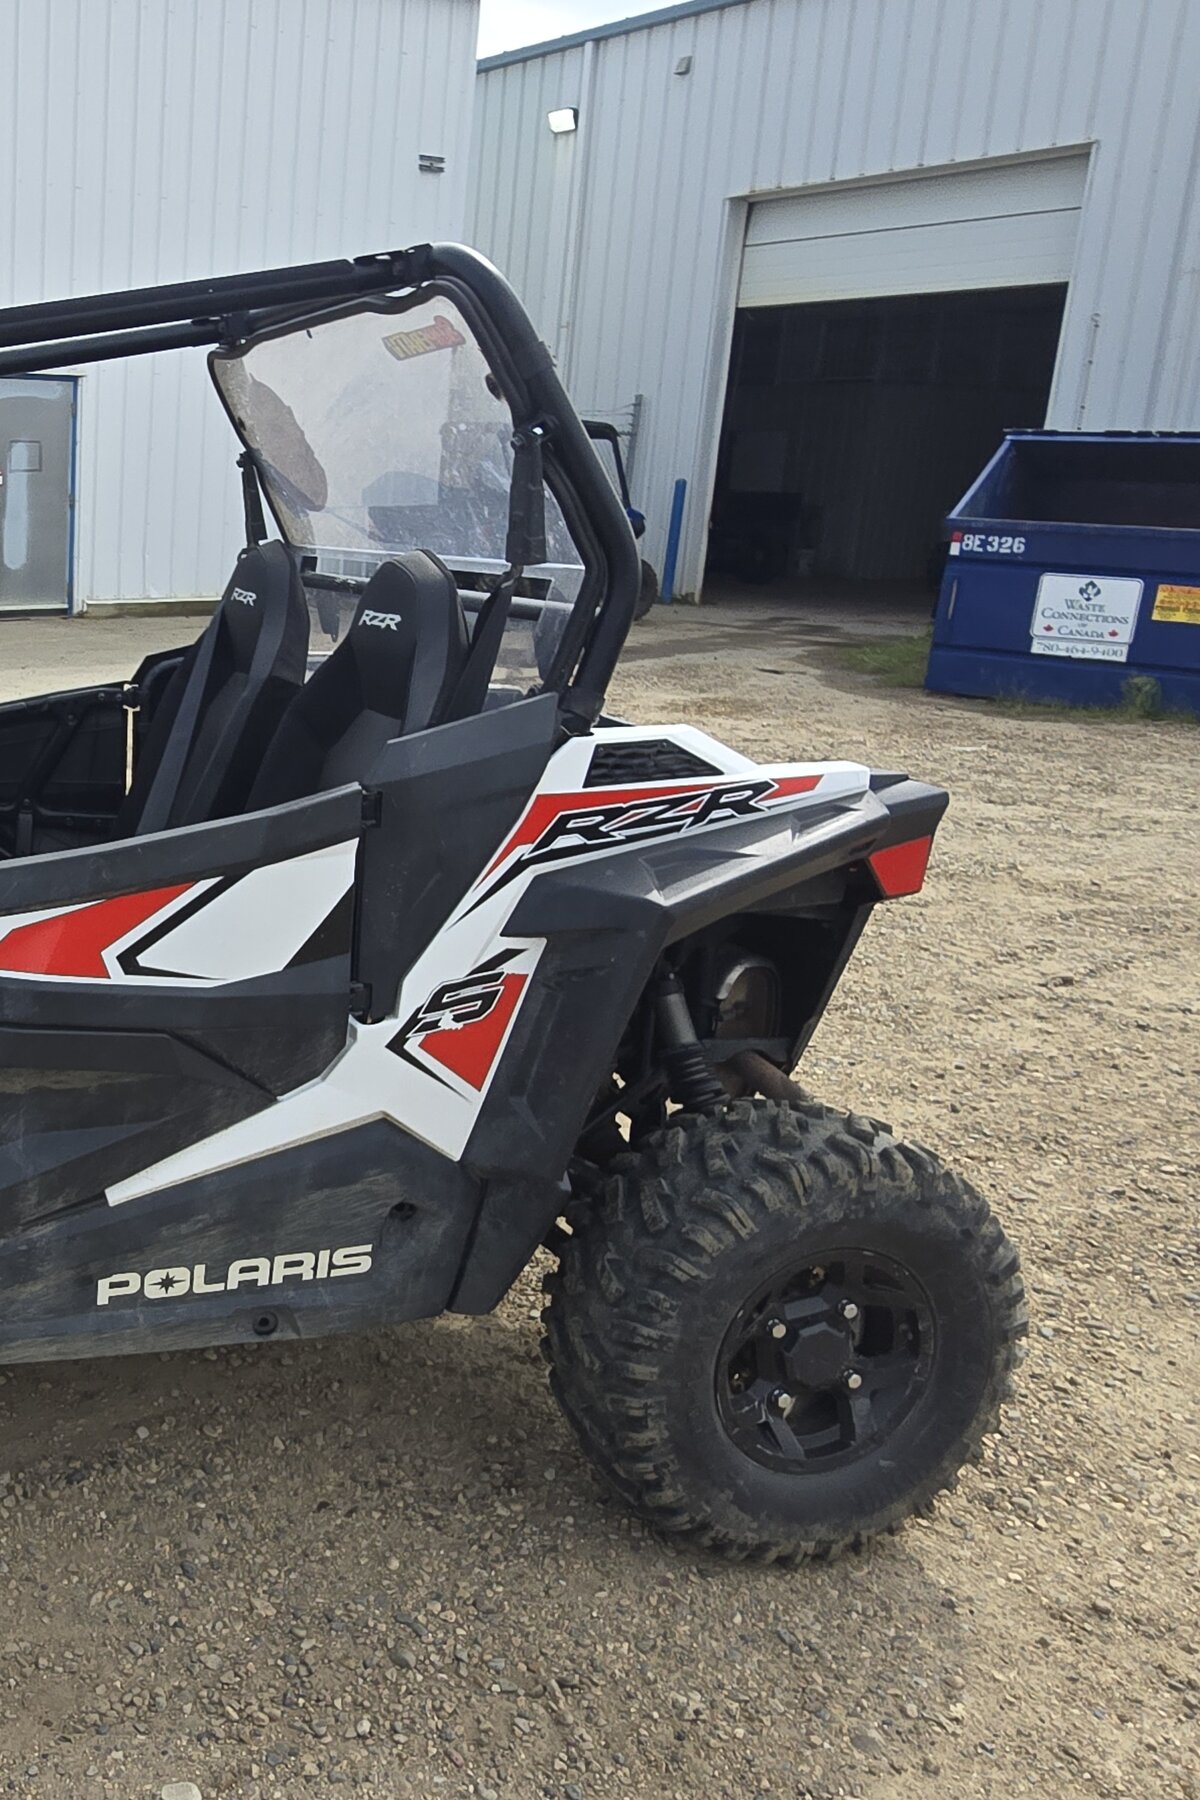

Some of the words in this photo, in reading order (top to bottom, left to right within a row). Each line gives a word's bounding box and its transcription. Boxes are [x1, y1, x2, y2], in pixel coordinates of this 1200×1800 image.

[986, 535, 1026, 554] 326
[231, 587, 257, 606] RZR
[1064, 598, 1106, 613] WASTE
[358, 609, 402, 631] RZR
[1041, 607, 1130, 625] CONNECTIONS
[1057, 625, 1105, 639] CANADA
[521, 778, 779, 862] RZR
[97, 1244, 373, 1306] POLARIS
